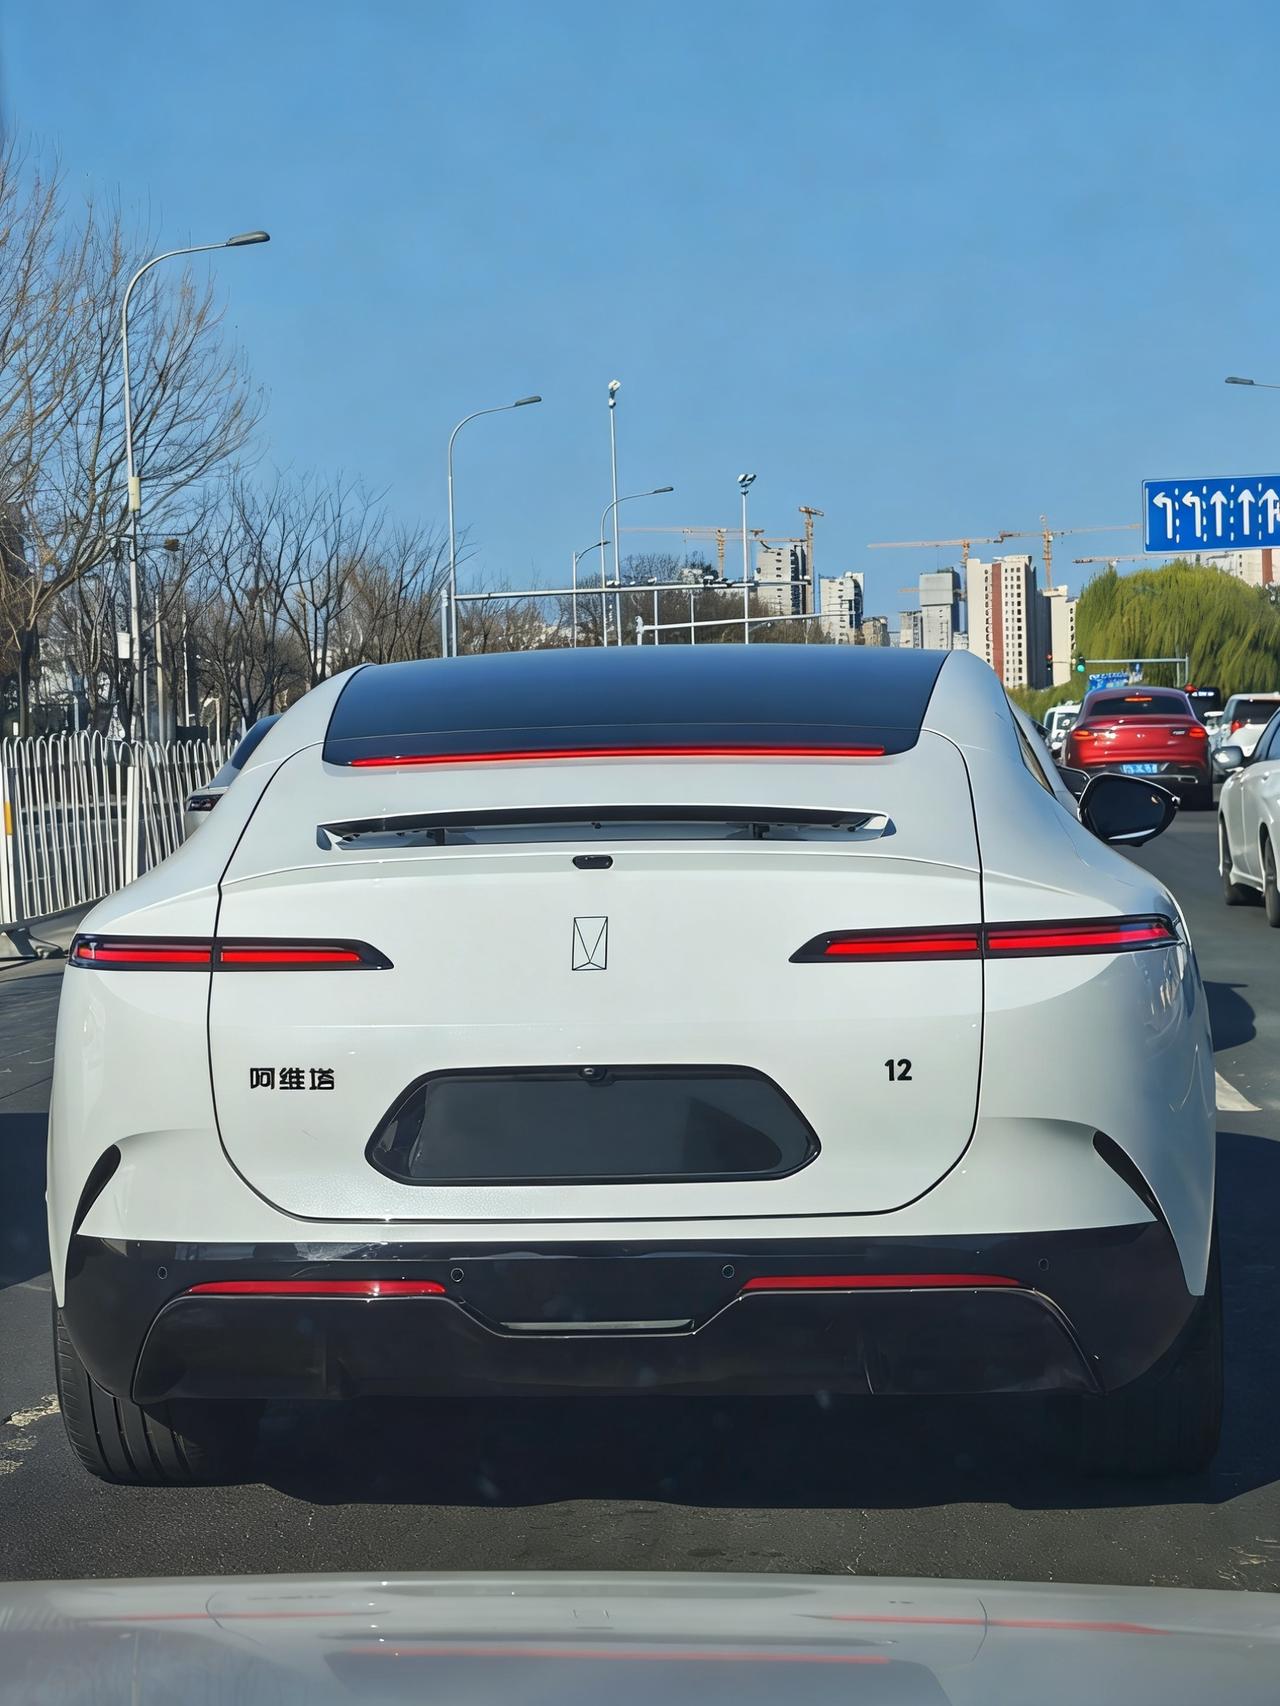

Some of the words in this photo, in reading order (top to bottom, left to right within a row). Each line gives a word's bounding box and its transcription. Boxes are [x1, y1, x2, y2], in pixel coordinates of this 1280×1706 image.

[250, 1067, 335, 1090] 阿维塔
[884, 1058, 913, 1081] 12
